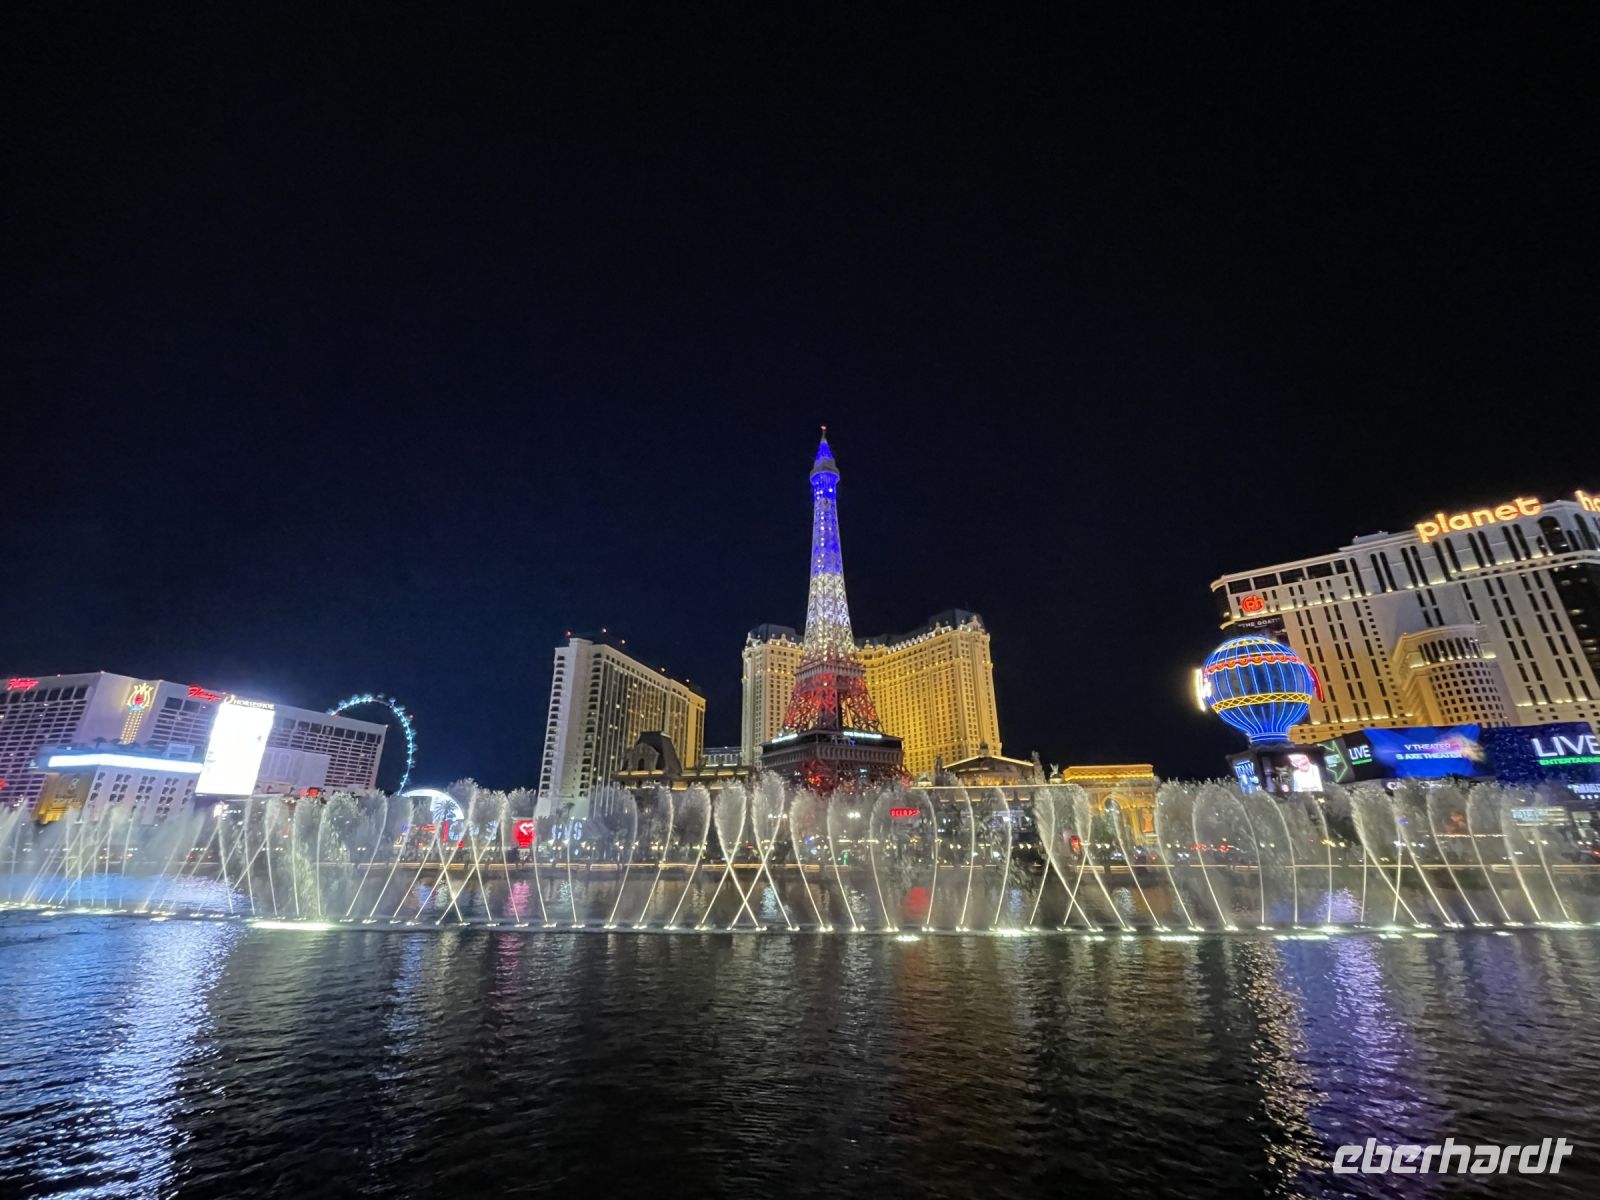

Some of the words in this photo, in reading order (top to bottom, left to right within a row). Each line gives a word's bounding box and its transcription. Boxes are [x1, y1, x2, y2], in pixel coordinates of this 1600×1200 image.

[1415, 498, 1541, 544] planet
[1349, 745, 1371, 760] LIVE
[1412, 743, 1451, 751] THEATER
[1531, 735, 1600, 757] LIVE
